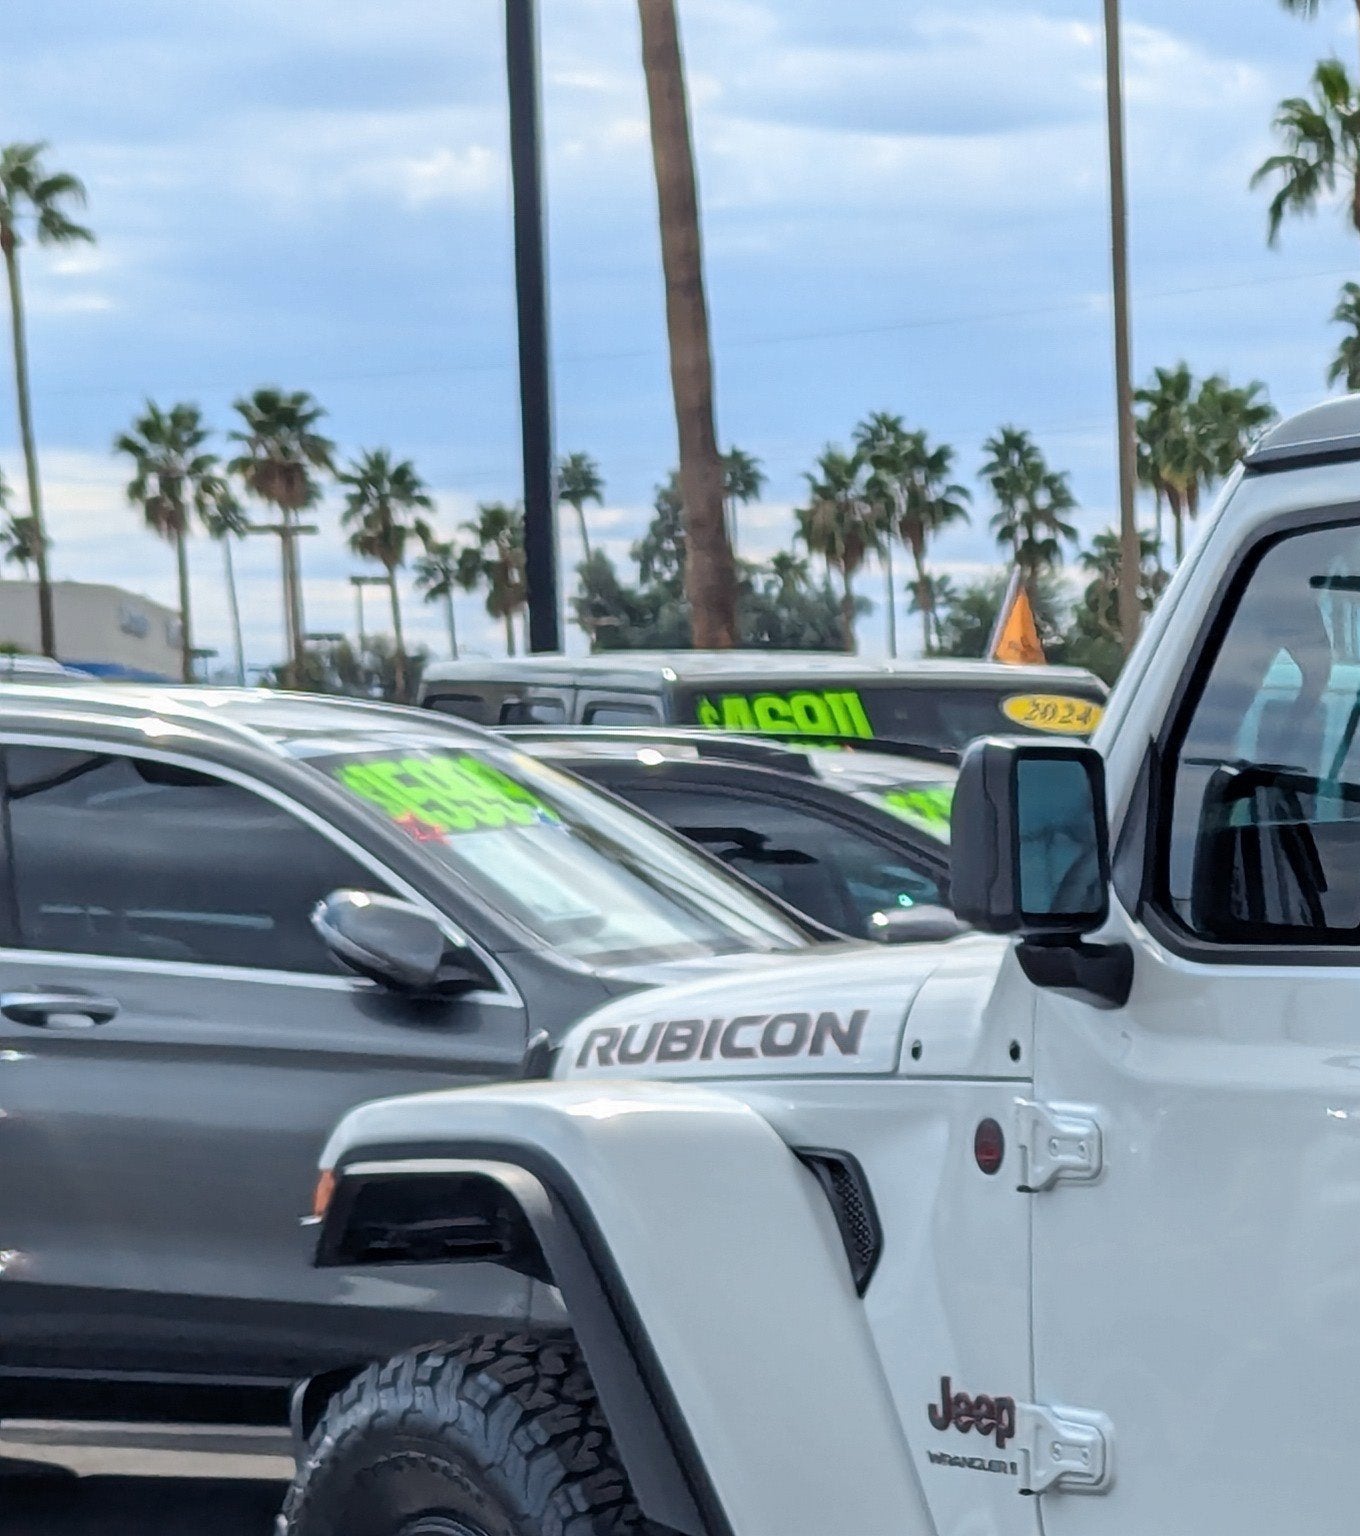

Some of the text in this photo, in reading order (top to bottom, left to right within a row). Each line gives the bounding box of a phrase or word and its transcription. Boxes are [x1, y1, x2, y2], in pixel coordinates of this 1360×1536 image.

[1023, 697, 1093, 726] 2024
[575, 1009, 870, 1069] RUBICON
[928, 1376, 1015, 1450] Jeep
